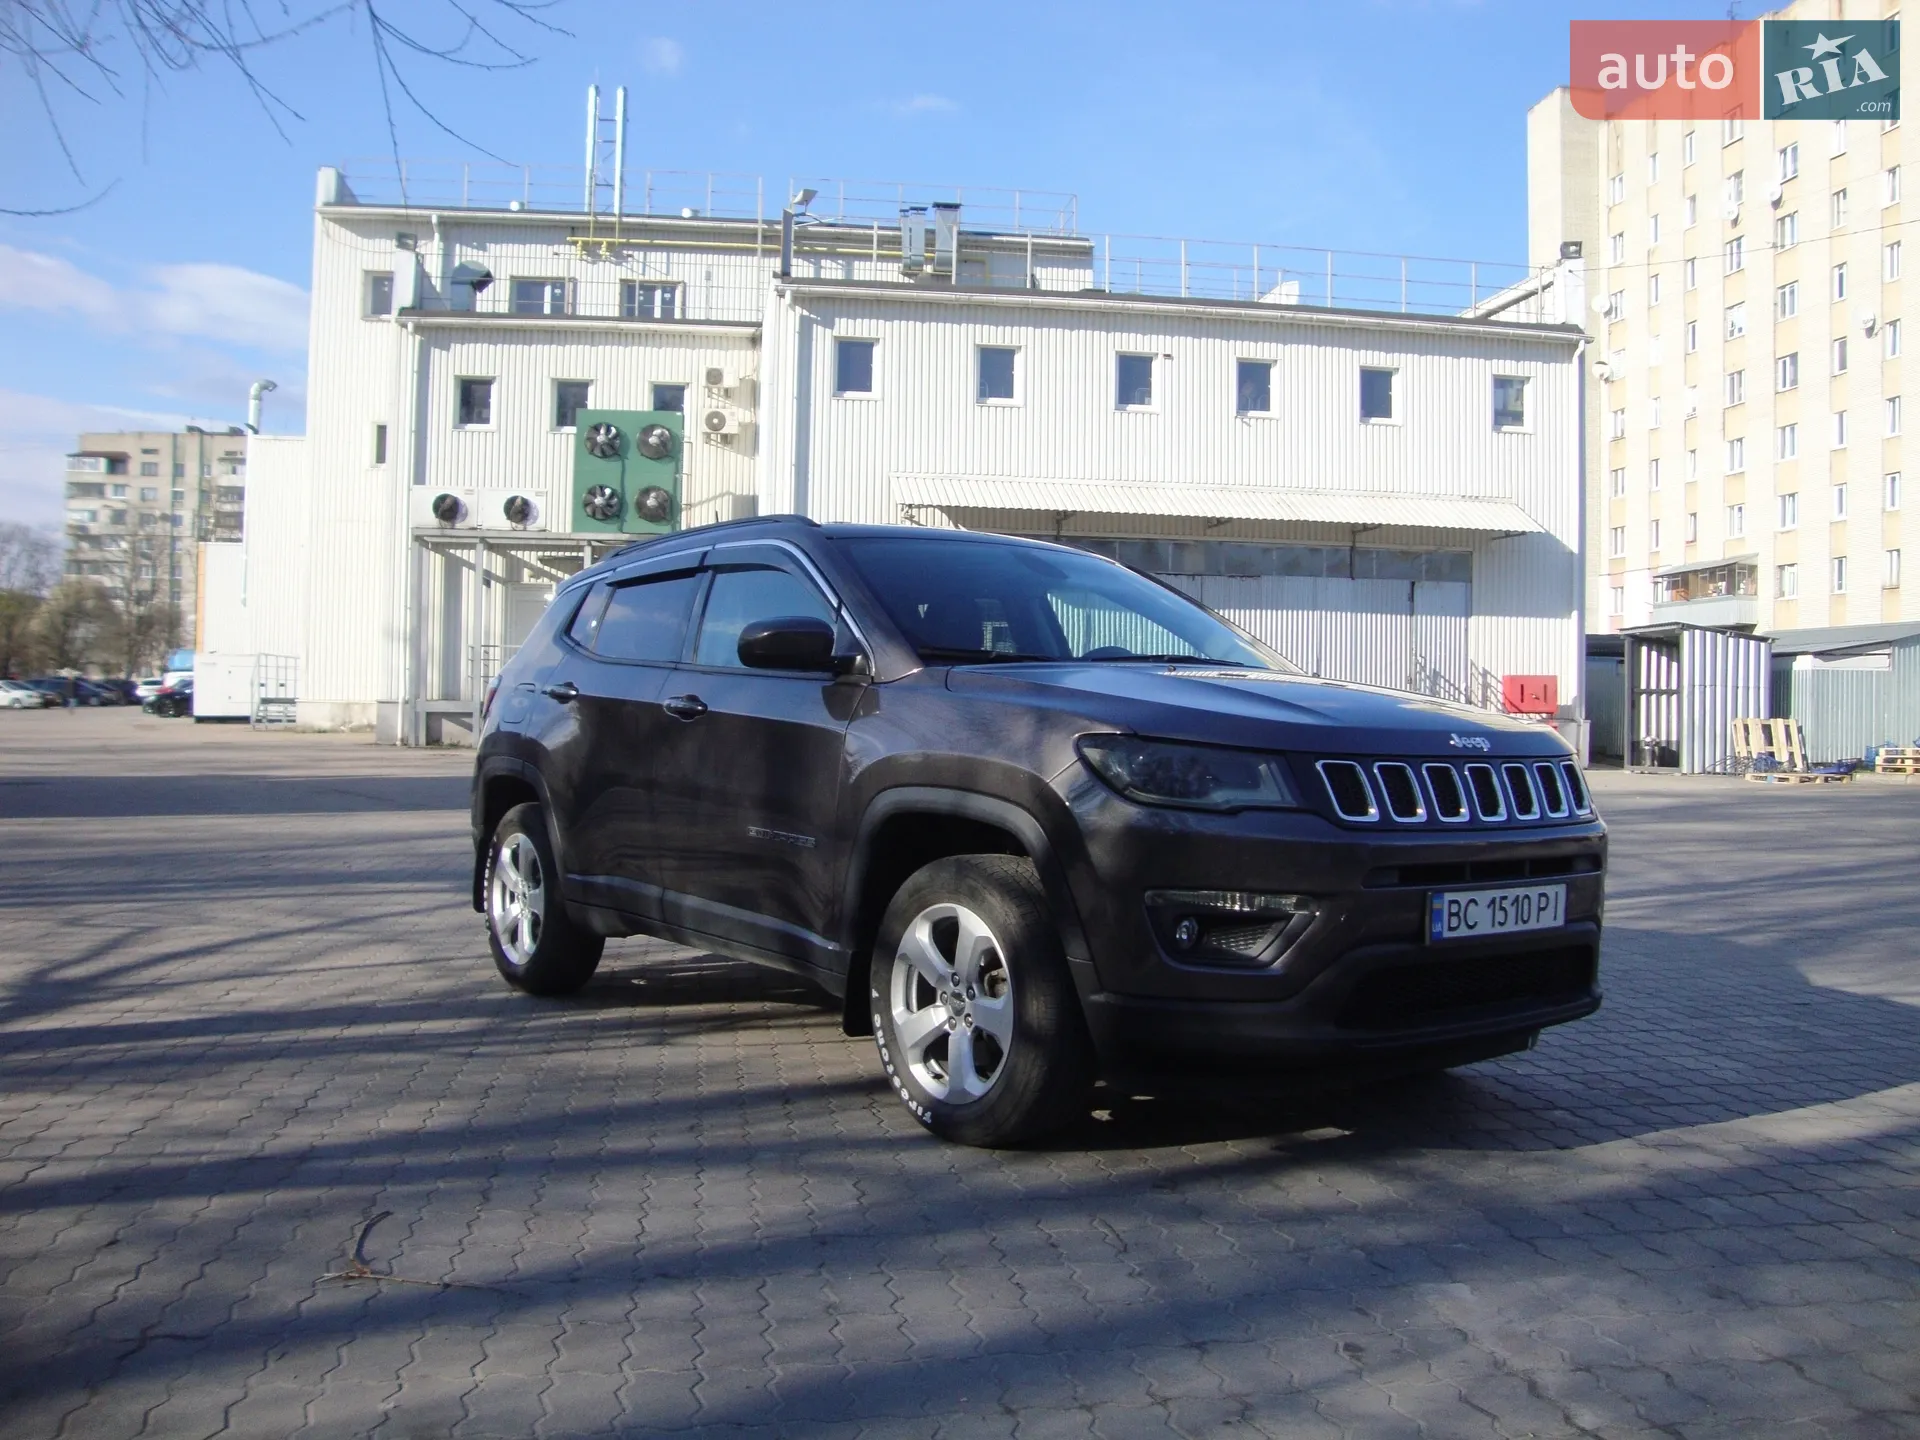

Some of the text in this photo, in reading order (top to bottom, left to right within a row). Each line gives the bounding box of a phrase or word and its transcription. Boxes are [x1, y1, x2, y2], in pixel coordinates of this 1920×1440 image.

[1449, 733, 1491, 752] Jeep
[1447, 891, 1559, 932] BC 1510 PI
[1432, 921, 1443, 933] UA
